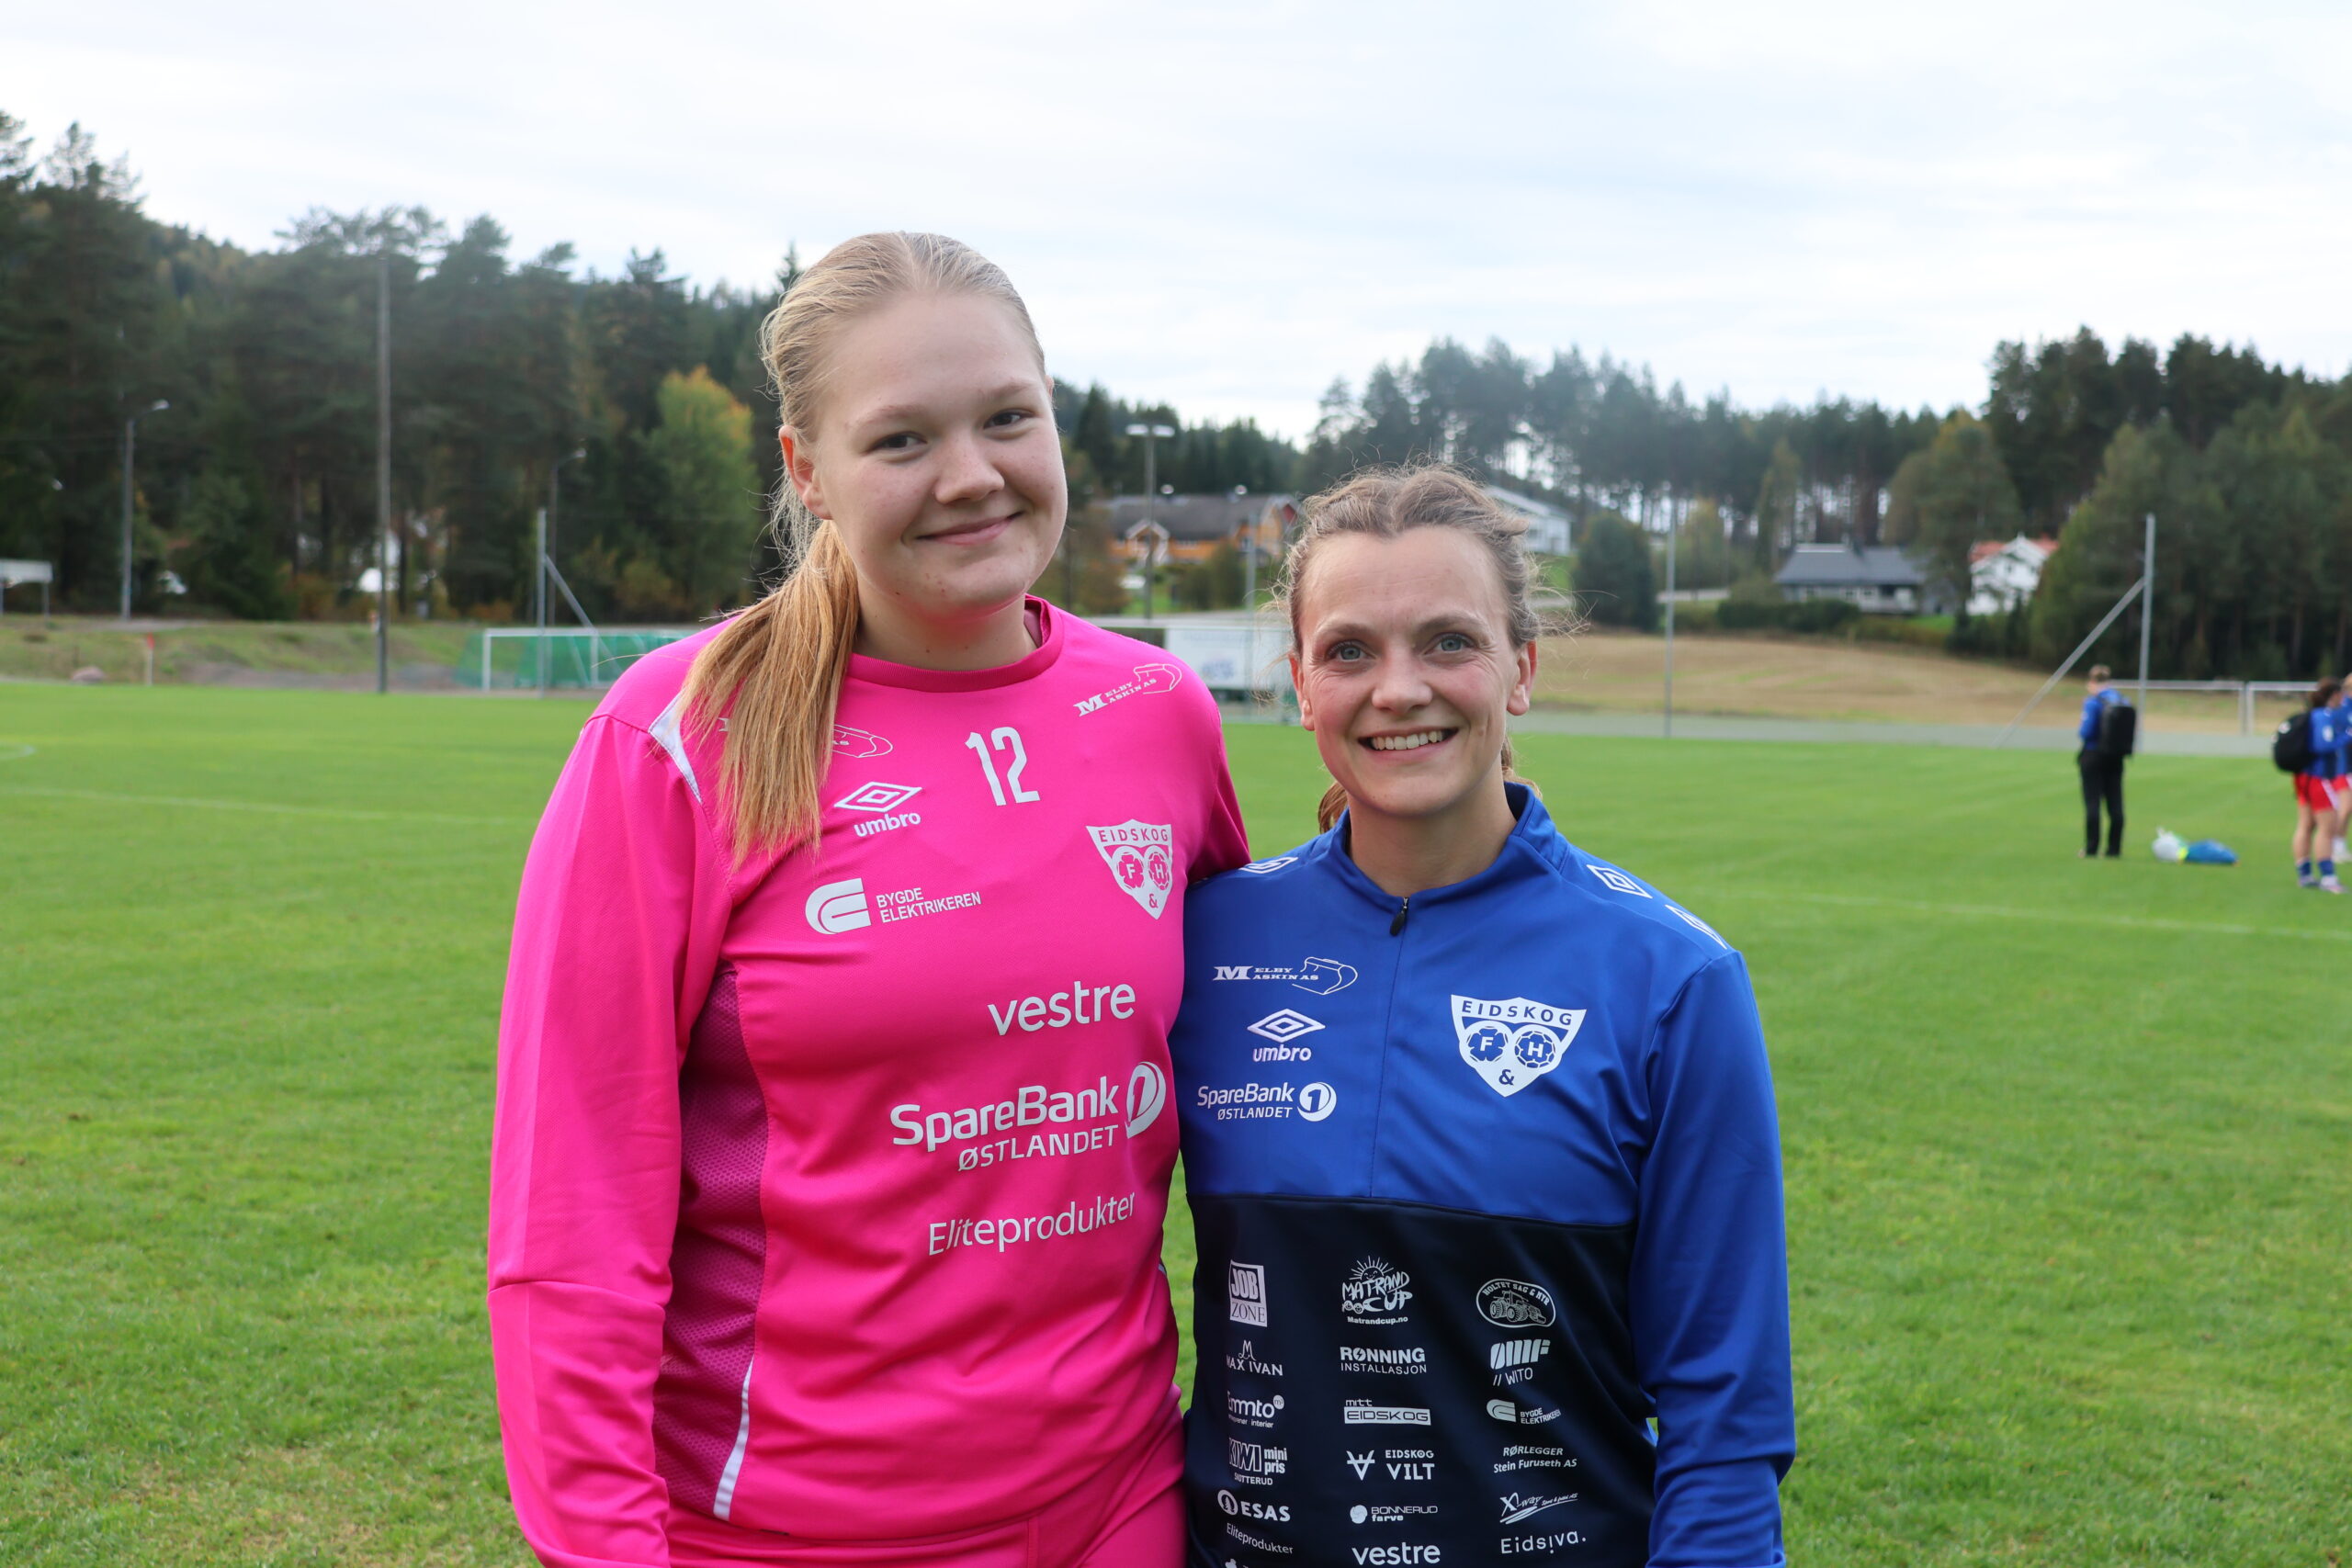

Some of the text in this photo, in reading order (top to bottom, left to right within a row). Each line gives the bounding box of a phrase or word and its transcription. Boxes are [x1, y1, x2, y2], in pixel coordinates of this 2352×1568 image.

[965, 727, 1040, 806] 12
[854, 810, 921, 838] umbro
[1098, 829, 1169, 842] EIDSKOG
[1126, 863, 1167, 879] F H
[876, 887, 922, 908] BYGDE
[880, 891, 981, 923] ELEKTRIKEREN
[987, 980, 1136, 1036] vestre
[1462, 1000, 1572, 1027] EIDSKOG
[1253, 1043, 1312, 1062] umbro
[1480, 1035, 1543, 1057] F H
[1498, 1069, 1515, 1086] &
[1197, 1082, 1295, 1111] SpareBank
[889, 1076, 1120, 1153] SpareBank
[1217, 1106, 1293, 1121] ØSTLANDET
[957, 1124, 1119, 1172] ØSTLANDET
[928, 1192, 1135, 1256] Eliteprodukter
[1231, 1269, 1259, 1300] JOB
[1341, 1271, 1410, 1301] MATRAND
[1363, 1290, 1413, 1312] CUP
[1231, 1302, 1265, 1323] ZONE
[1347, 1316, 1408, 1325] Matrandcup.no
[1249, 1360, 1283, 1376] IVAN
[1340, 1363, 1427, 1375] INSTALLASJON
[1505, 1367, 1533, 1385] WITO
[1345, 1398, 1373, 1406] mitt
[1347, 1410, 1429, 1422] EIDSKOG
[1520, 1407, 1544, 1418] BYGDE
[1263, 1447, 1288, 1461] mini
[1385, 1450, 1434, 1459] EIDSKOG
[1503, 1445, 1564, 1457] RØRLEGGER
[1264, 1460, 1285, 1476] pris
[1385, 1463, 1435, 1481] VILT
[1493, 1459, 1577, 1473] Stein Furuseth AS
[1240, 1501, 1291, 1522] ESAS
[1371, 1506, 1438, 1515] BONNERUD
[1227, 1522, 1294, 1554] Eliteprodukter
[1351, 1541, 1441, 1565] vestre
